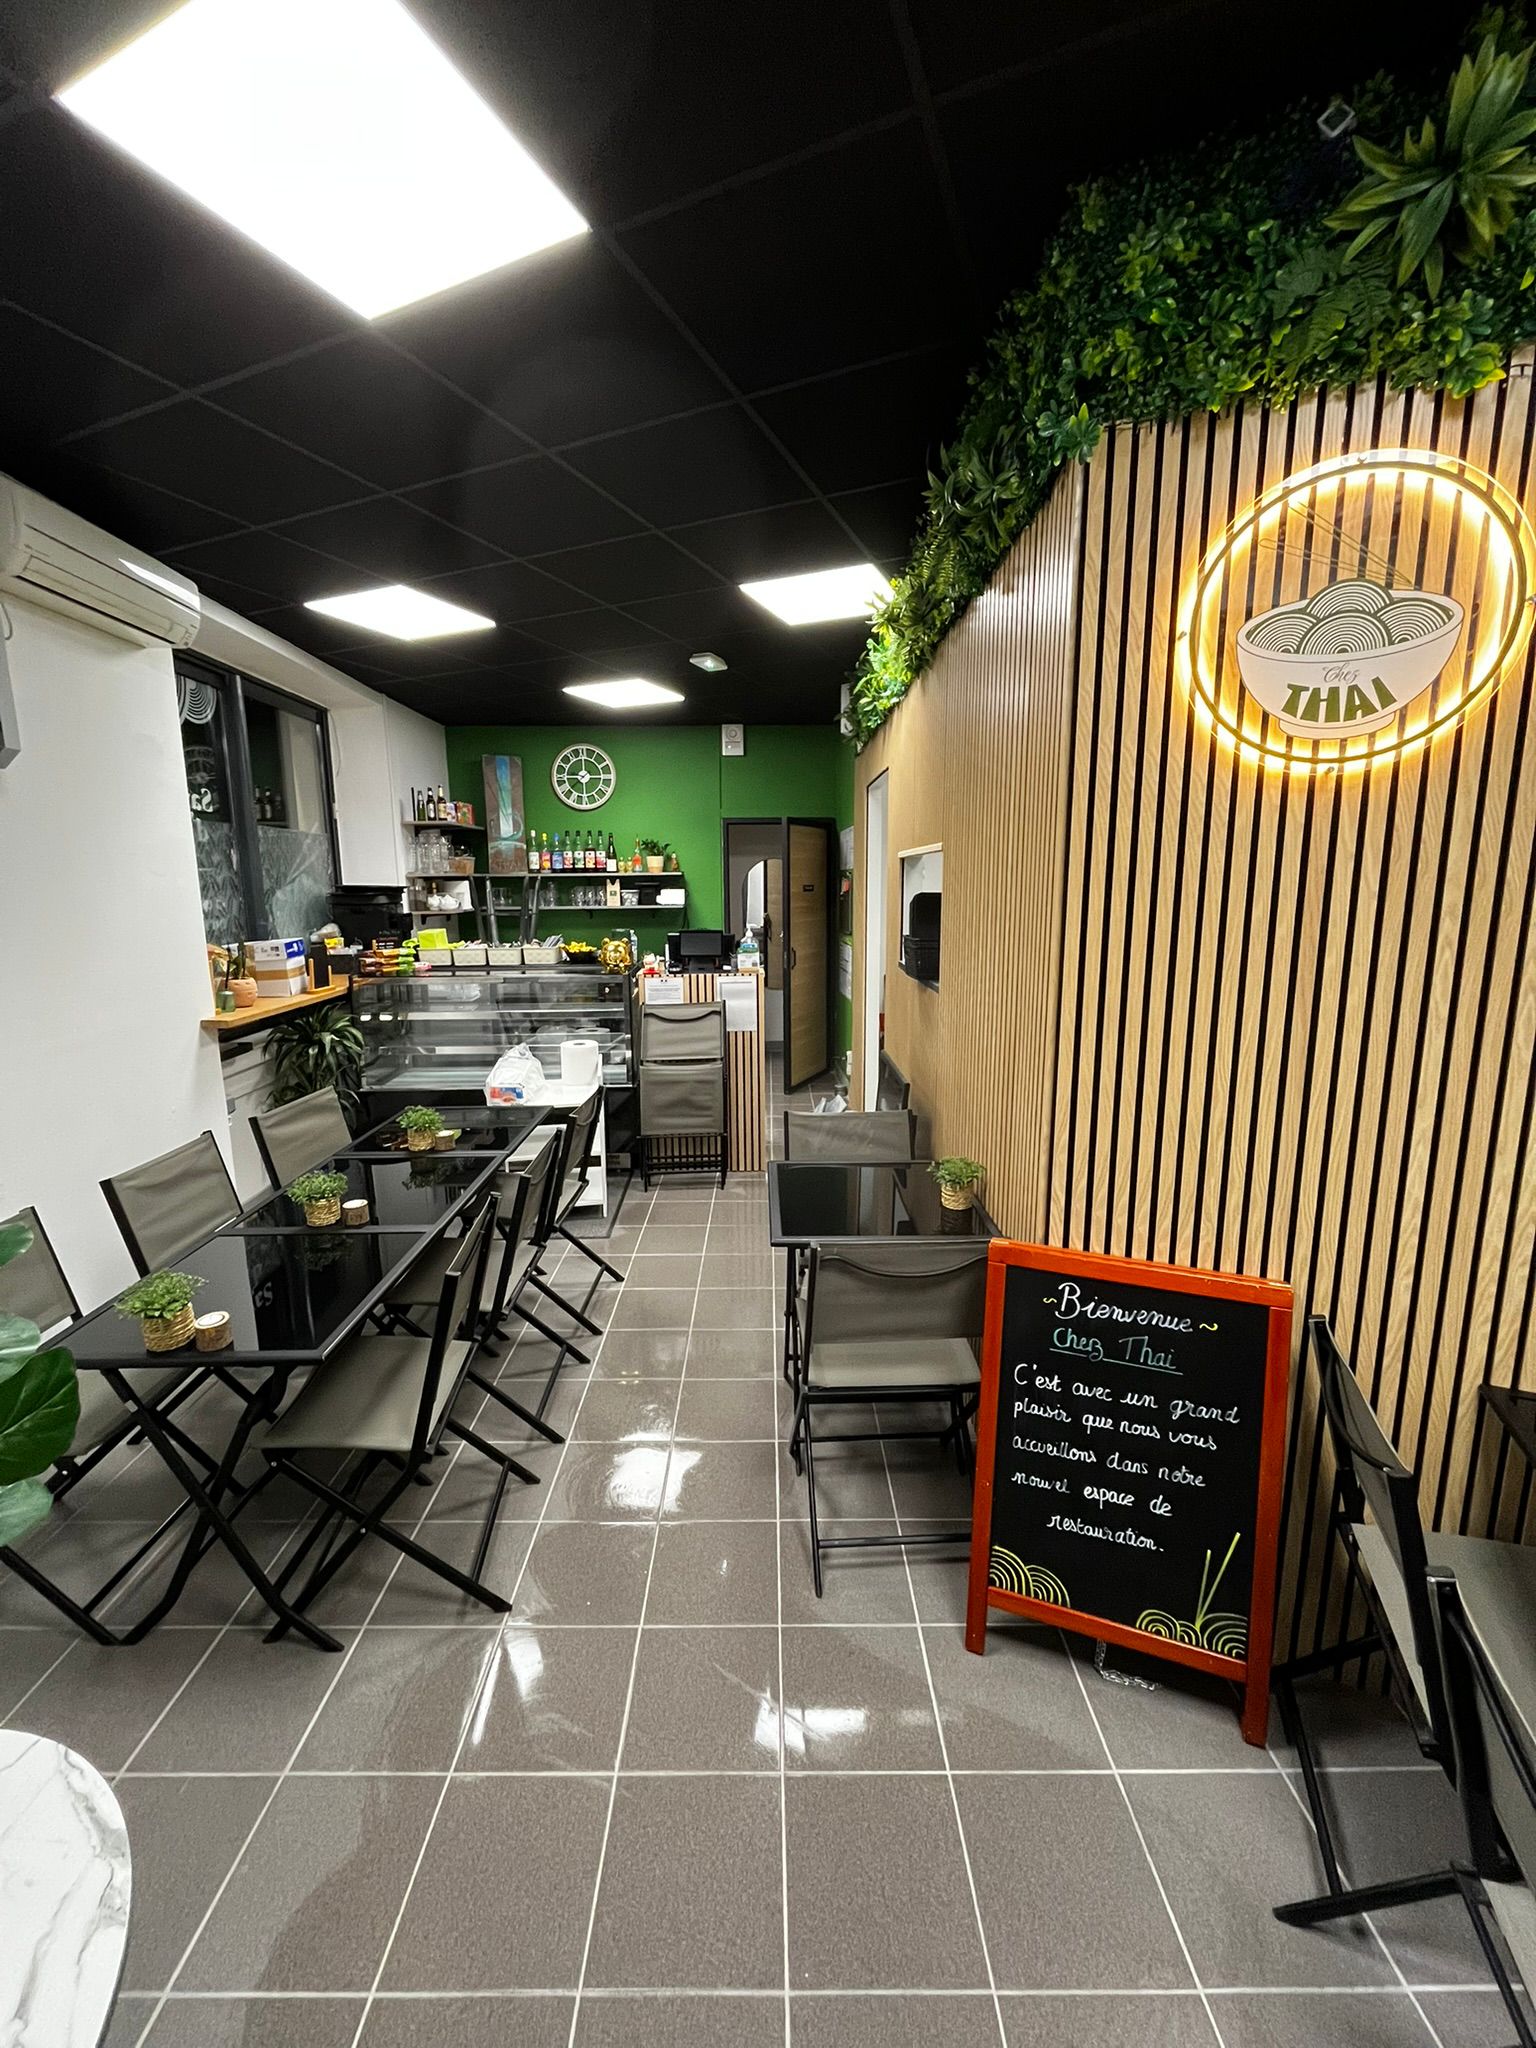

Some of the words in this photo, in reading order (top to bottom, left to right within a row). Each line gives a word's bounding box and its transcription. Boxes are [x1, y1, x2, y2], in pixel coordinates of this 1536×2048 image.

[1322, 662, 1360, 685] Chez
[1281, 676, 1398, 723] THAI
[1055, 1282, 1193, 1332] Bienvenue
[1053, 1327, 1104, 1361] Chez
[1118, 1336, 1177, 1369] Thai
[1014, 1363, 1062, 1392] C'est
[1072, 1382, 1113, 1401] avec
[1120, 1392, 1158, 1409] un
[1169, 1399, 1240, 1424] grand
[1014, 1398, 1072, 1423] plaisir
[1082, 1413, 1114, 1434] que
[1119, 1421, 1161, 1440] nous
[1168, 1430, 1217, 1451] vous
[1012, 1435, 1097, 1463] accueillons
[1106, 1452, 1149, 1475] dans
[1158, 1465, 1206, 1487] notre
[1011, 1471, 1071, 1494] nouvel
[1083, 1484, 1135, 1510] espace
[1150, 1494, 1173, 1516] de
[1046, 1514, 1165, 1552] restauration.
